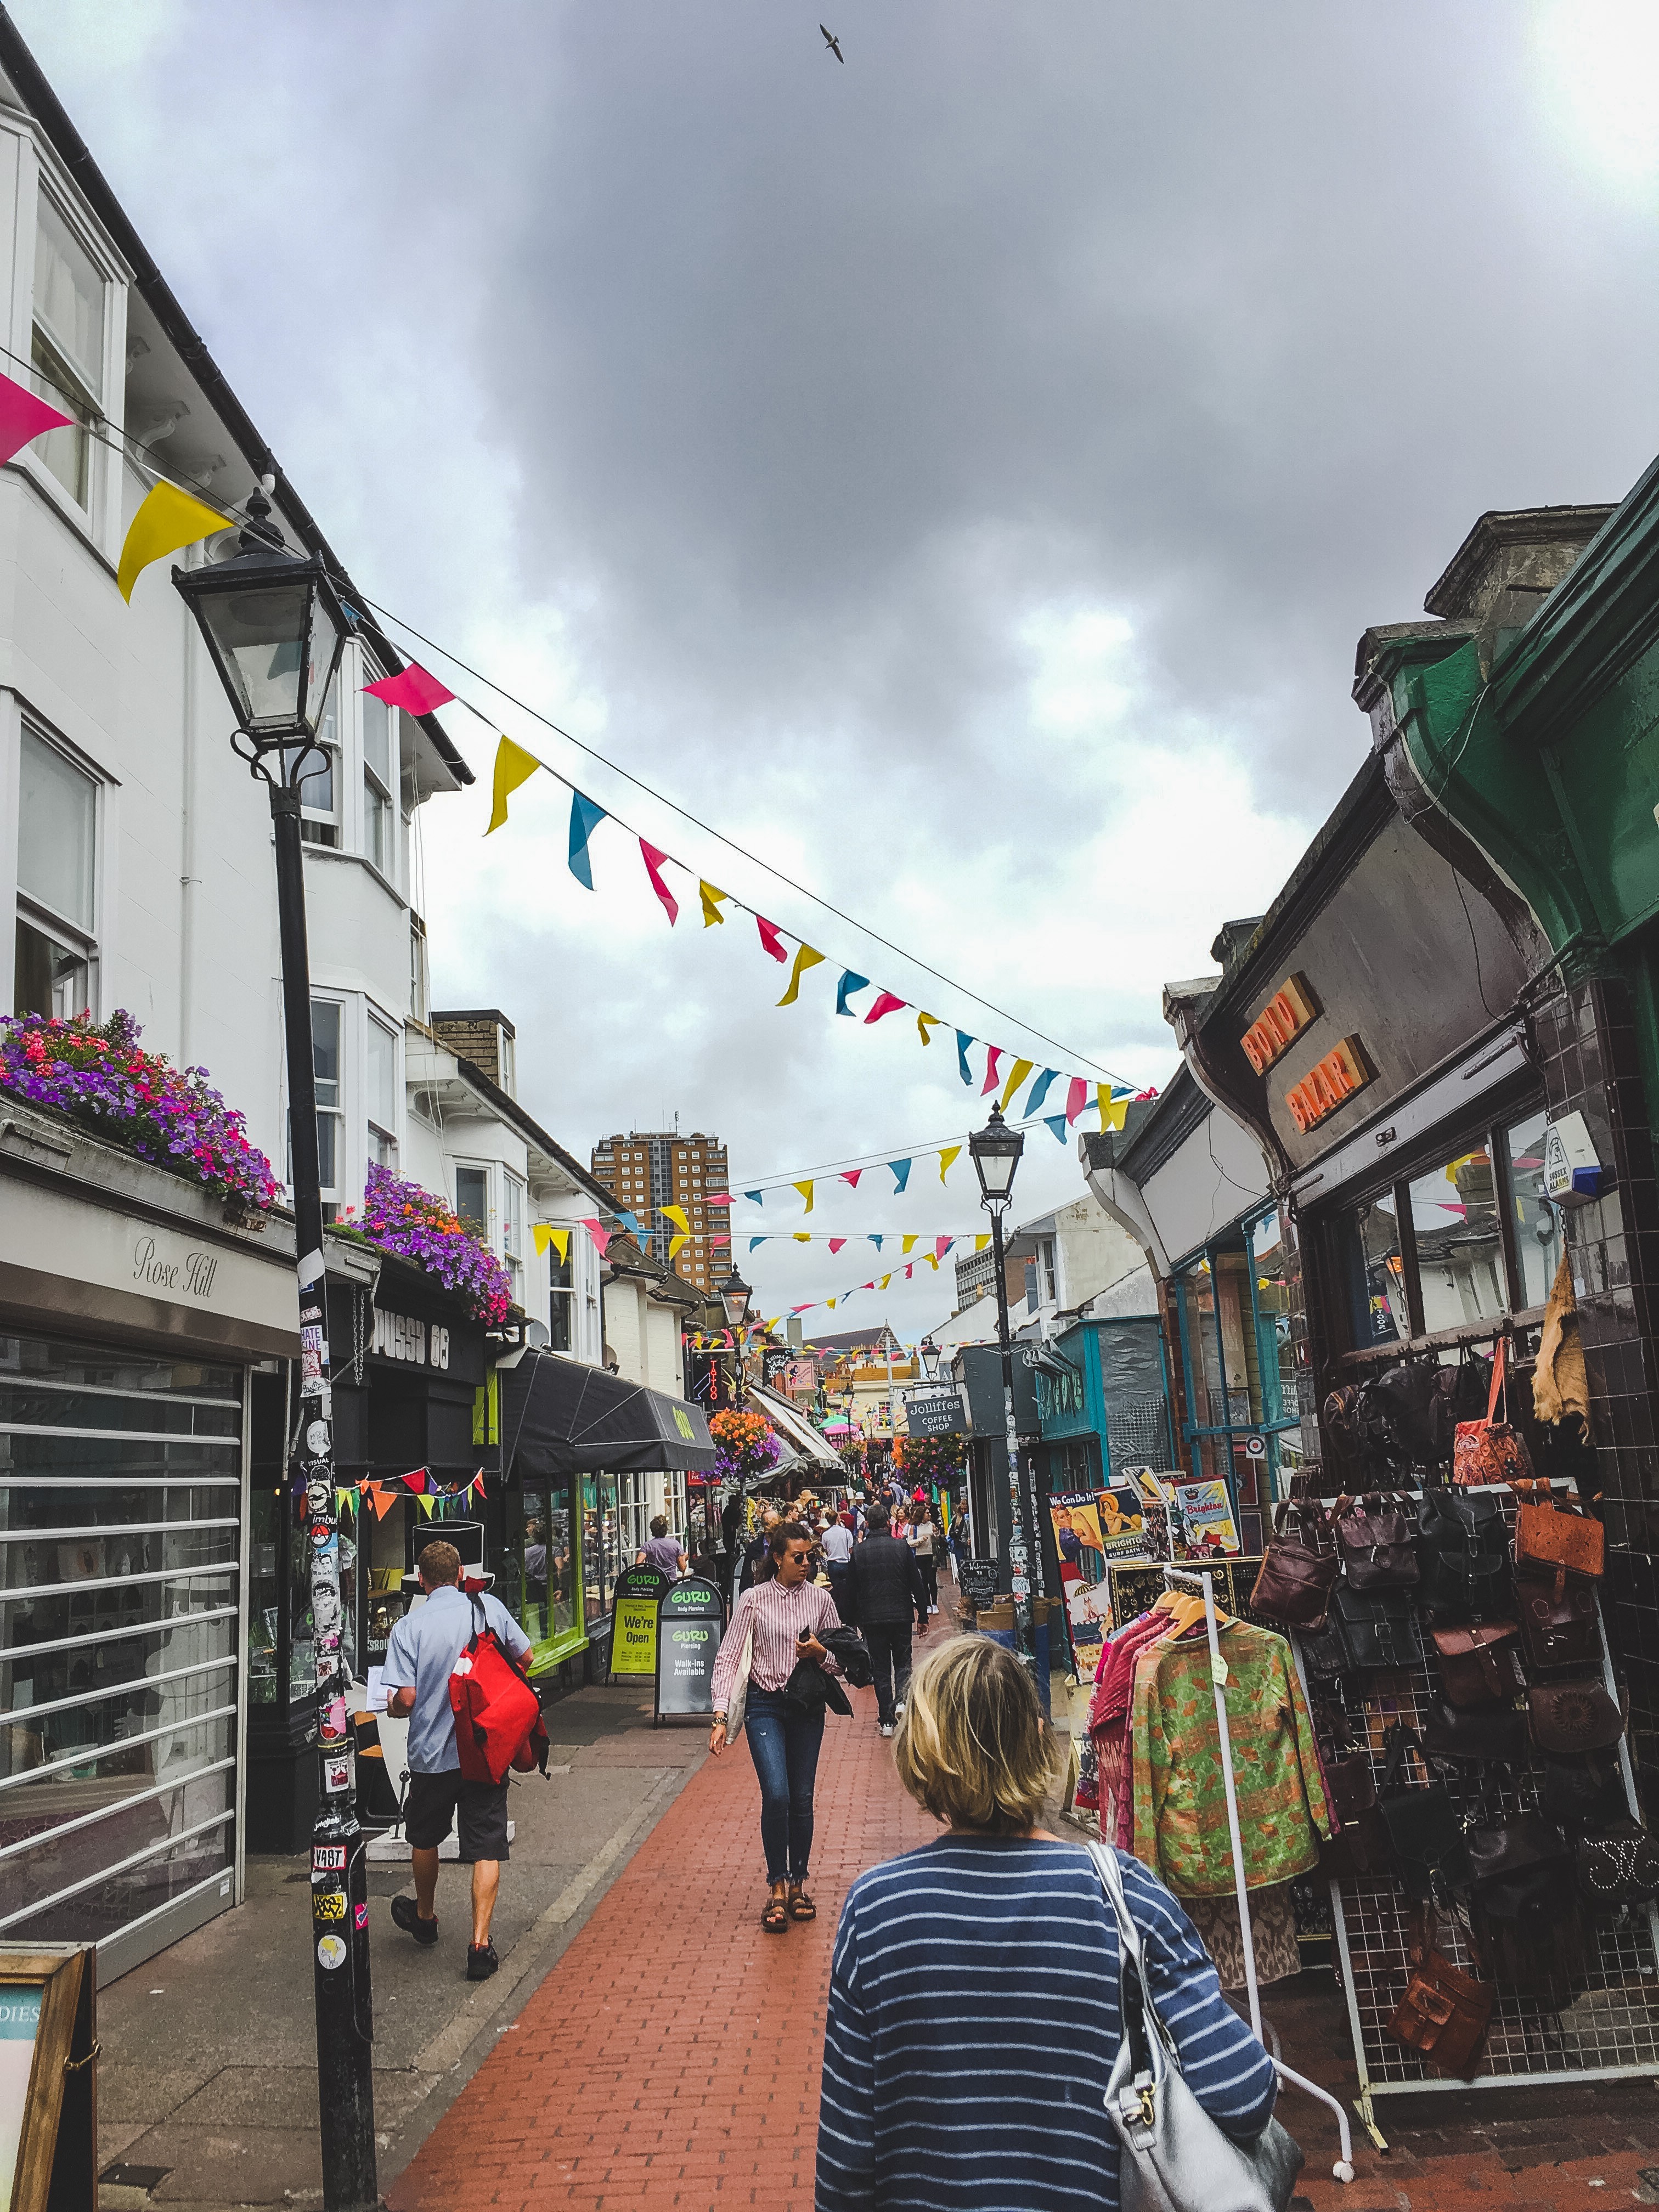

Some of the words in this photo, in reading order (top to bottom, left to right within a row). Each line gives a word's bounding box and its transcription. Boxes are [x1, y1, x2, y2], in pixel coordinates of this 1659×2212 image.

[1240, 992, 1300, 1070] BOHO
[1285, 1051, 1356, 1131] BAZAR
[1549, 1166, 1567, 1181] SUSSEX
[1549, 1175, 1570, 1191] ALARMS
[133, 1237, 180, 1289] Rose
[183, 1252, 218, 1298] Hill
[301, 1327, 320, 1340] HATE
[371, 1307, 425, 1364] PUSSY
[910, 1400, 960, 1415] Jolliffes
[922, 1414, 953, 1425] COFFEE
[927, 1423, 950, 1432] SHOP
[308, 1457, 329, 1466] VISUAL
[1049, 1497, 1062, 1506] We
[1062, 1495, 1075, 1505] Can
[1075, 1493, 1086, 1503] Do
[1086, 1492, 1095, 1502] It!
[1185, 1502, 1223, 1514] Brighton
[627, 1574, 659, 1585] GURU
[671, 1590, 711, 1604] GURU
[624, 1615, 654, 1629] We're
[626, 1631, 649, 1645] Open
[672, 1630, 708, 1642] GURU
[674, 1667, 705, 1676] Available
[0, 2005, 41, 2023] DIES
